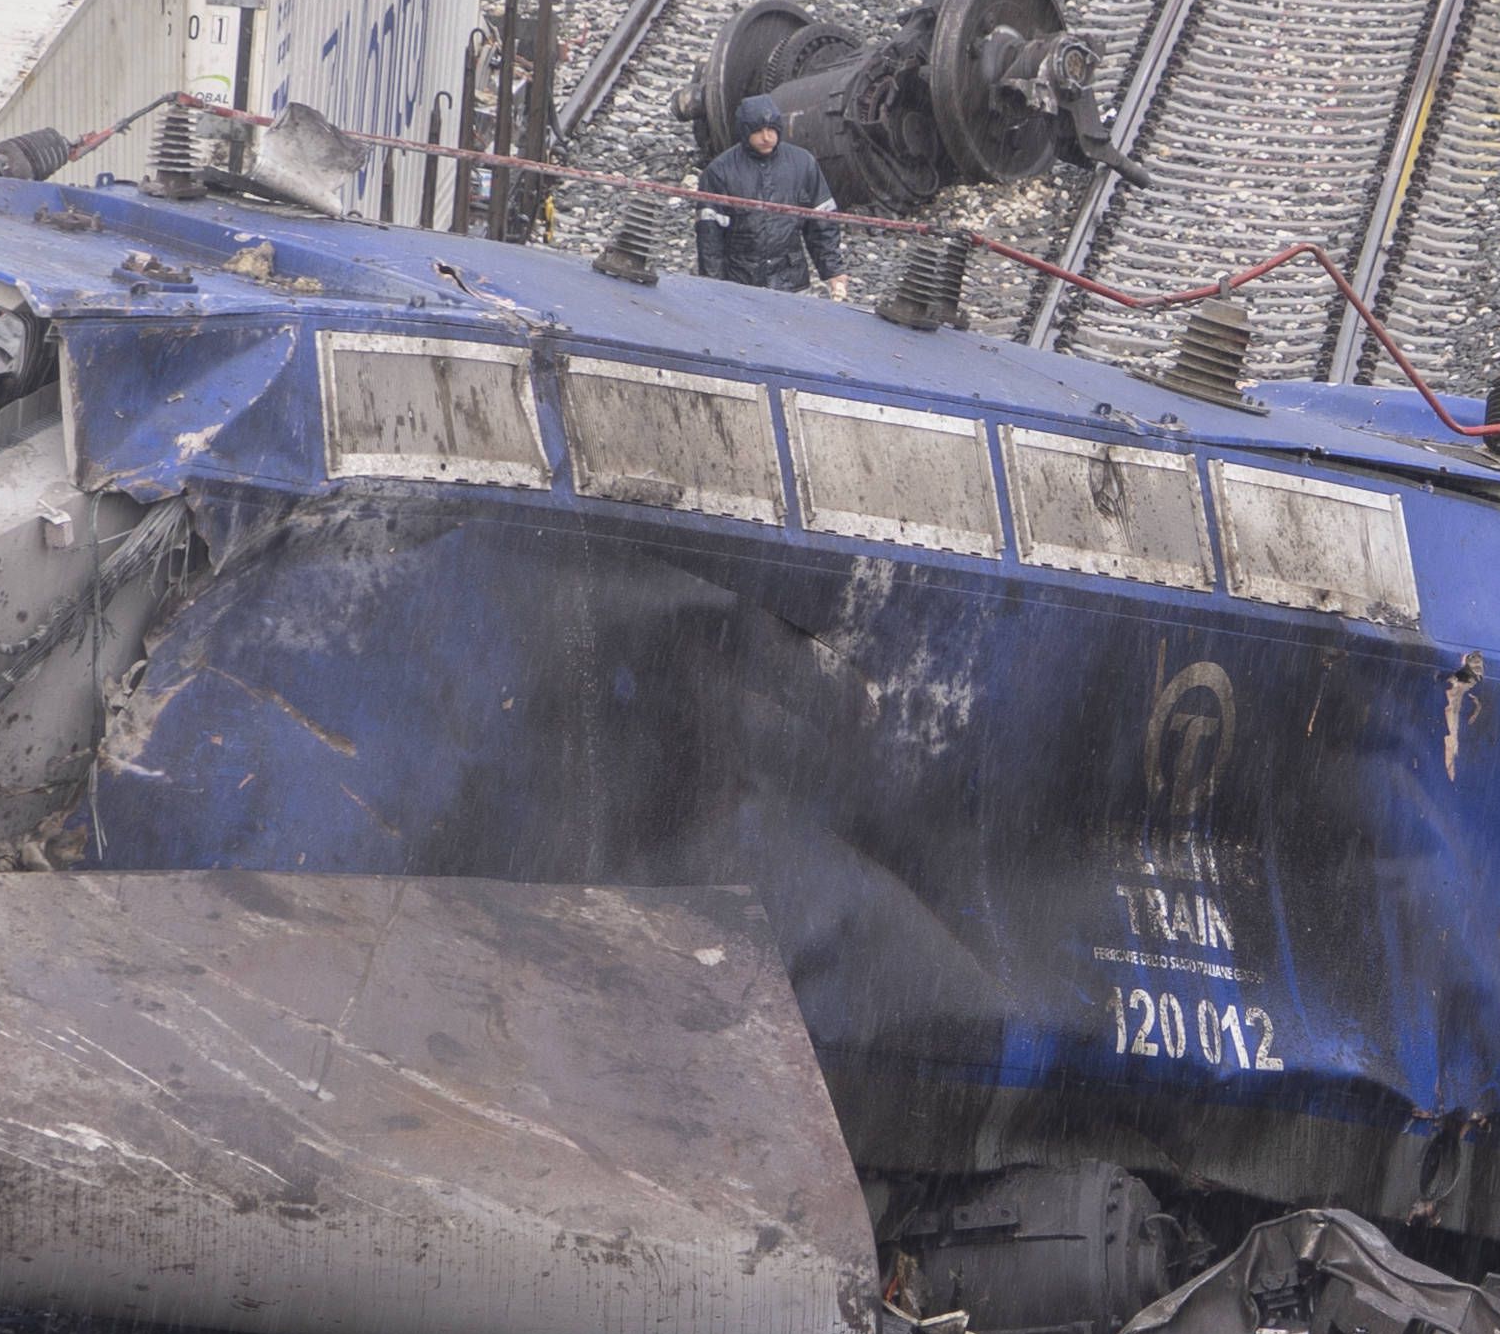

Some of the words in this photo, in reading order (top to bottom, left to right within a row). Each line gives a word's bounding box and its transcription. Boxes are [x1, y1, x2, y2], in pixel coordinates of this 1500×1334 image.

[1116, 884, 1235, 951] TRAIN
[1107, 986, 1187, 1059] 120
[1197, 999, 1284, 1072] 012
